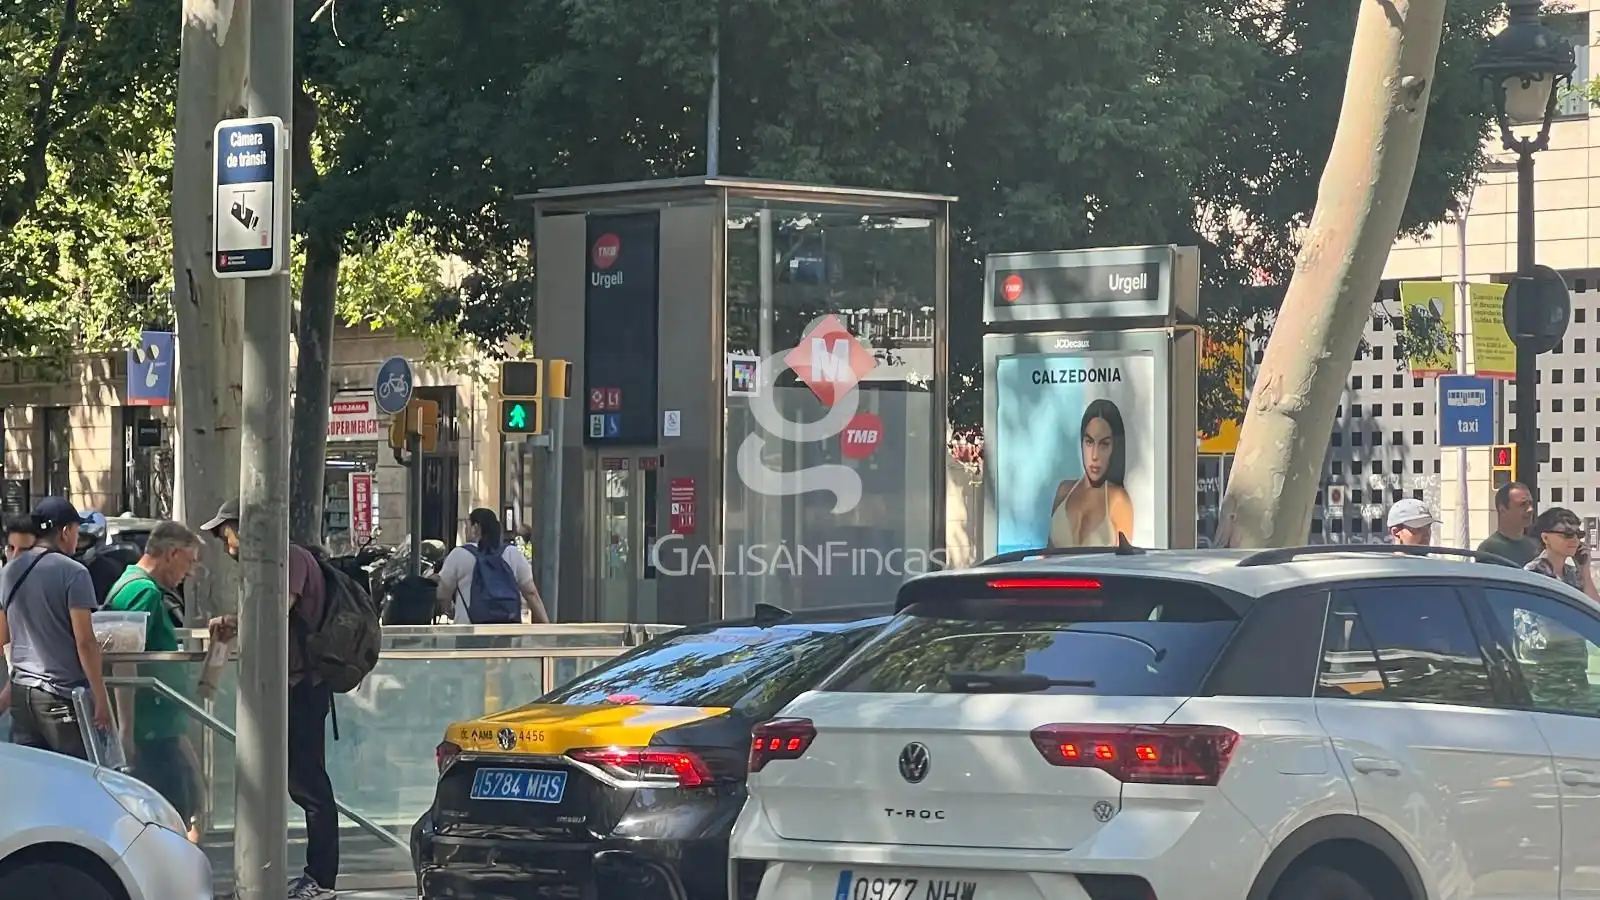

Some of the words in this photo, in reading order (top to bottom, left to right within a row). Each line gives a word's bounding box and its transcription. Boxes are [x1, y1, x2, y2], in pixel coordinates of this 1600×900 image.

[230, 131, 263, 148] Càmera
[226, 152, 239, 168] de
[239, 150, 267, 167] trànsit
[591, 271, 623, 289] Urgell
[1108, 272, 1148, 294] Urgell
[1054, 338, 1091, 349] JCDecaux
[811, 337, 850, 382] M
[1031, 367, 1122, 385] CALZEDONIA
[1457, 418, 1479, 433] taxi
[847, 430, 878, 444] TMB
[356, 482, 368, 531] SUPER
[519, 730, 545, 742] 4456
[483, 772, 522, 796] 5784
[525, 774, 561, 798] MHS
[884, 808, 945, 820] T-ROC
[854, 876, 918, 900] 0977
